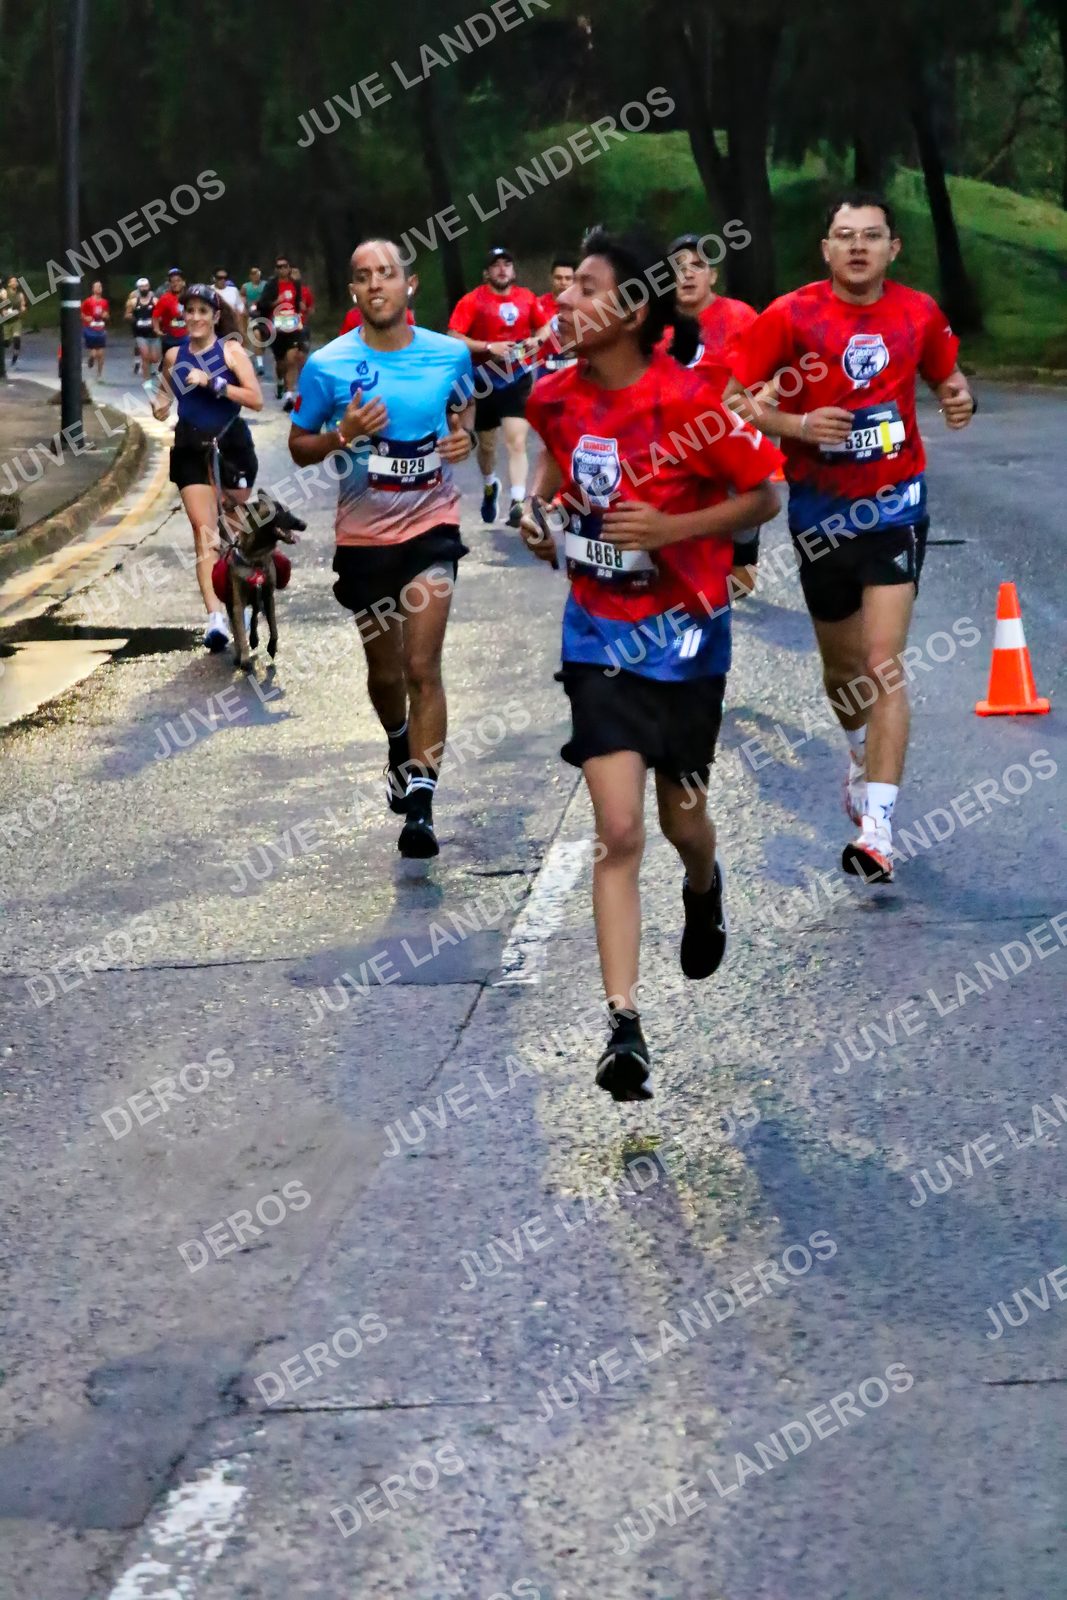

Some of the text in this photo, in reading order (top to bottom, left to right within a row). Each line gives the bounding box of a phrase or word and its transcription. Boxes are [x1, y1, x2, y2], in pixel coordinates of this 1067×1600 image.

[845, 429, 879, 450] 5321
[391, 458, 425, 475] 4929
[586, 541, 623, 568] 4868
